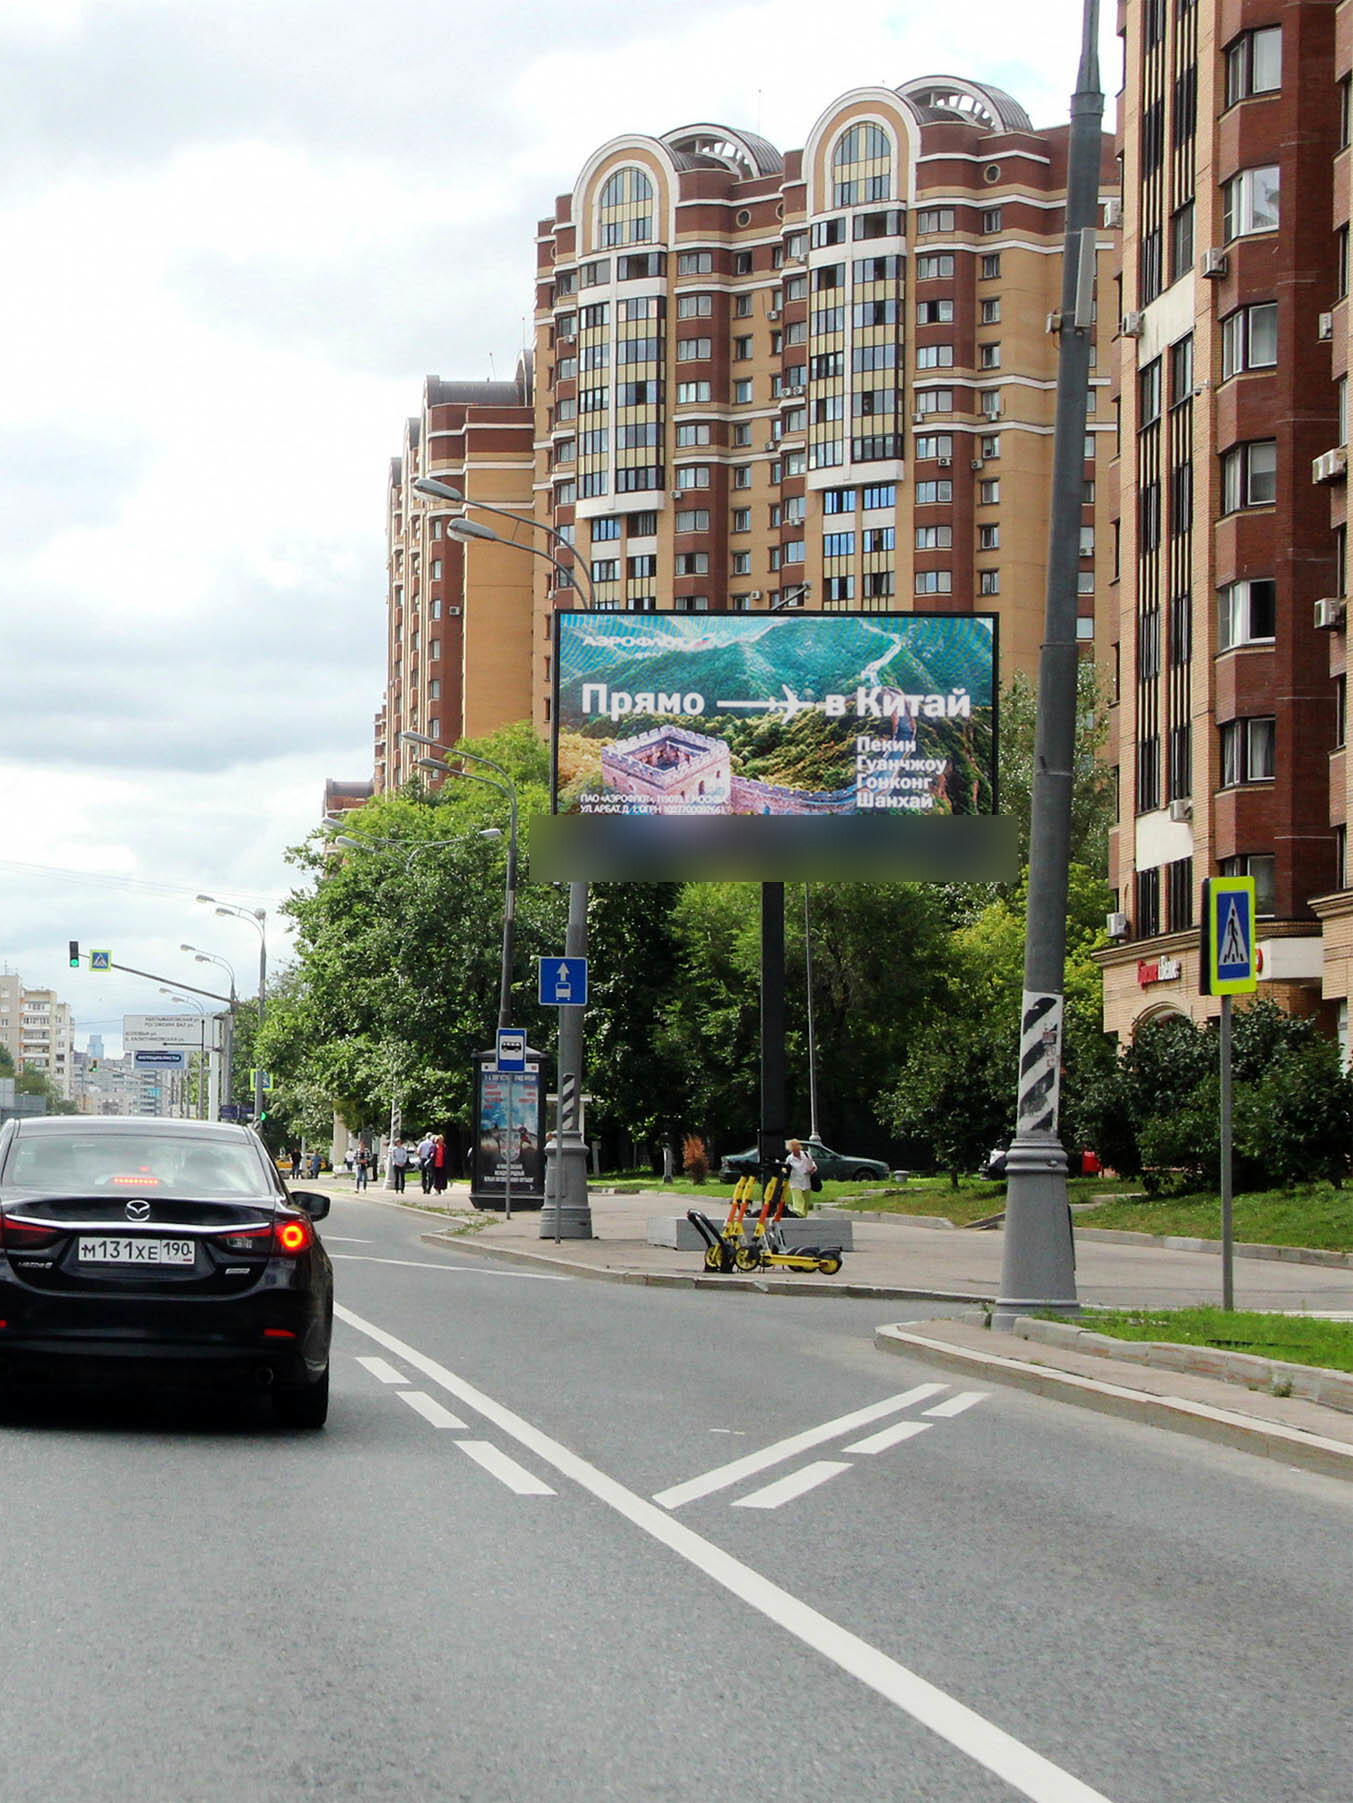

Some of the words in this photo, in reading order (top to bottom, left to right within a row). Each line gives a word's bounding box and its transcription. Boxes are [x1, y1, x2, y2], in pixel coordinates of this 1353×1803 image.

[582, 683, 705, 721] Прямо
[825, 693, 846, 717] в
[856, 687, 971, 718] Китай
[856, 737, 917, 752] Пекин
[856, 756, 947, 774] Гуанчжоу
[856, 774, 933, 790] Гонконг
[856, 791, 934, 808] Шанхай
[163, 1241, 190, 1256] 190
